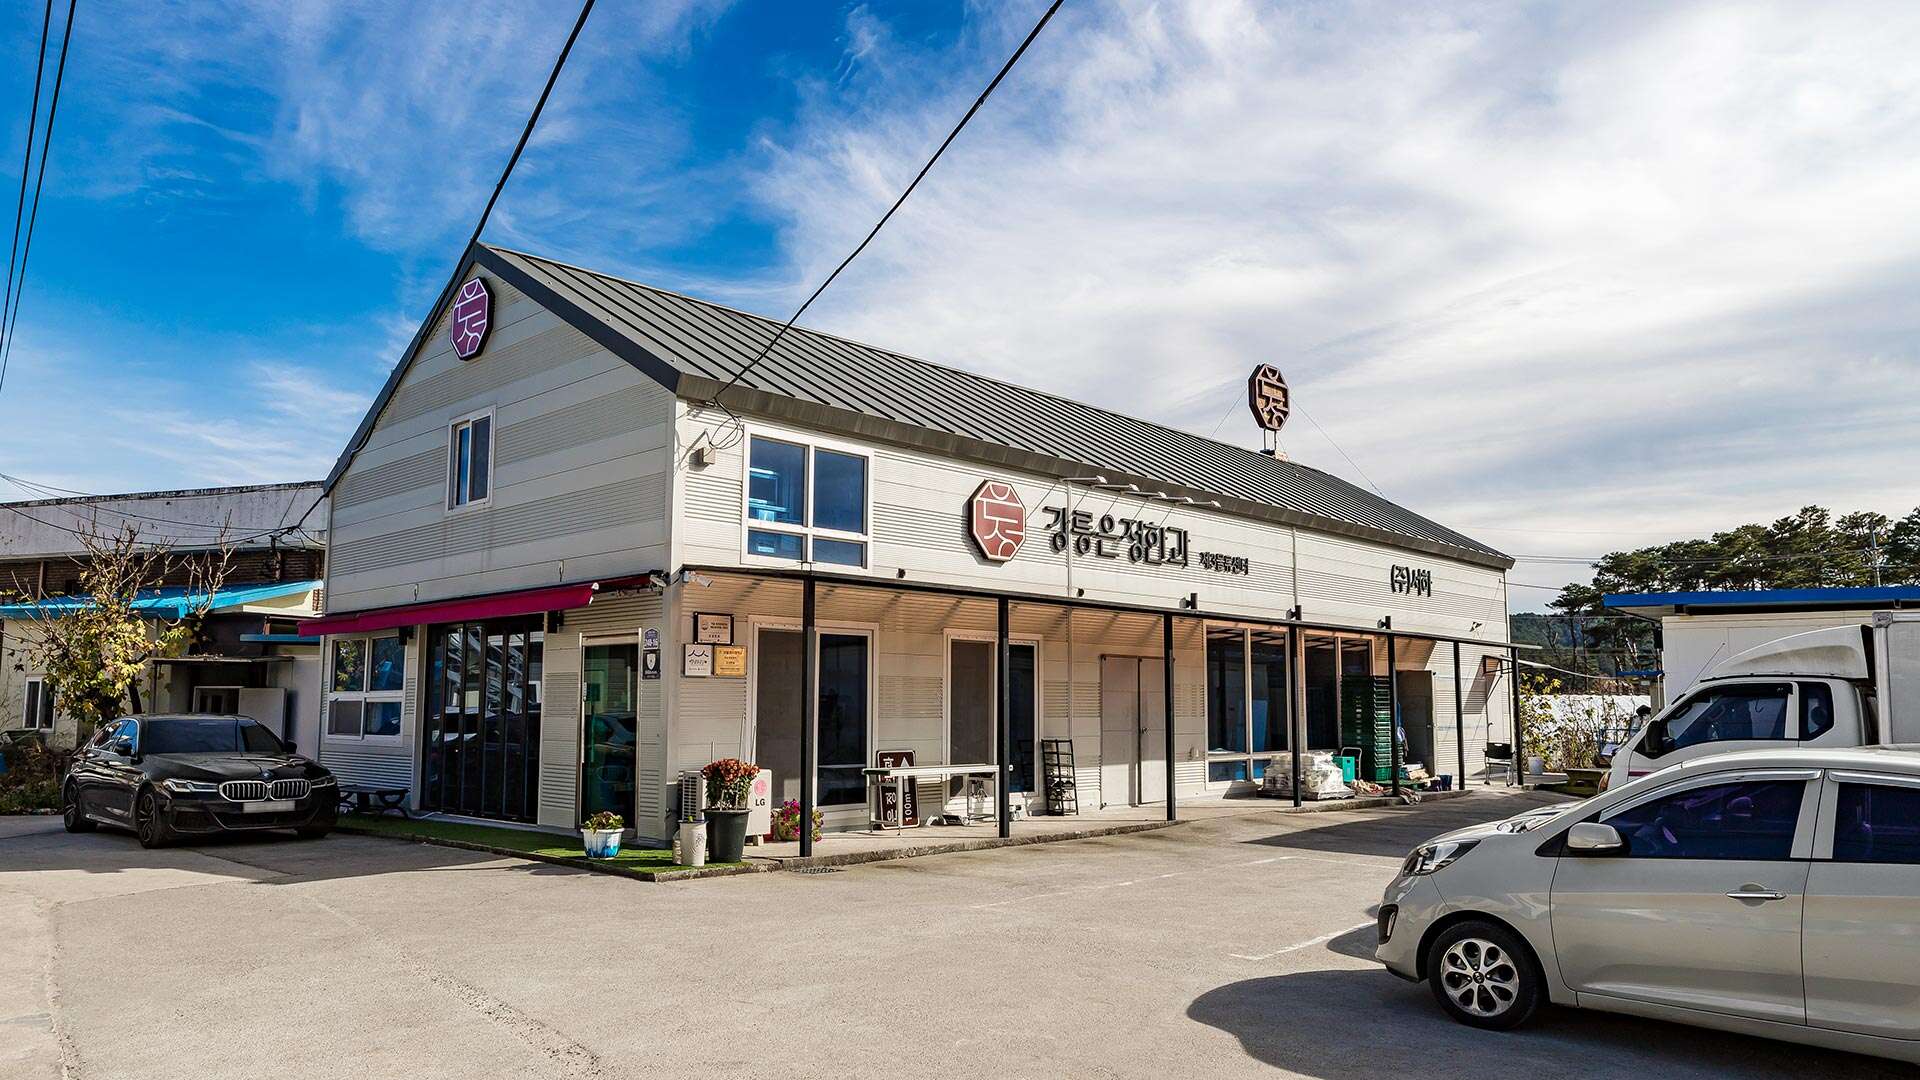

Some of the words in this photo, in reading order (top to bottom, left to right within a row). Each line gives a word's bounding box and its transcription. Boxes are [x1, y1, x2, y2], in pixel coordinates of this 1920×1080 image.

[1042, 506, 1189, 567] 강릉은정한과
[755, 798, 766, 807] LG
[904, 793, 912, 822] 100m
